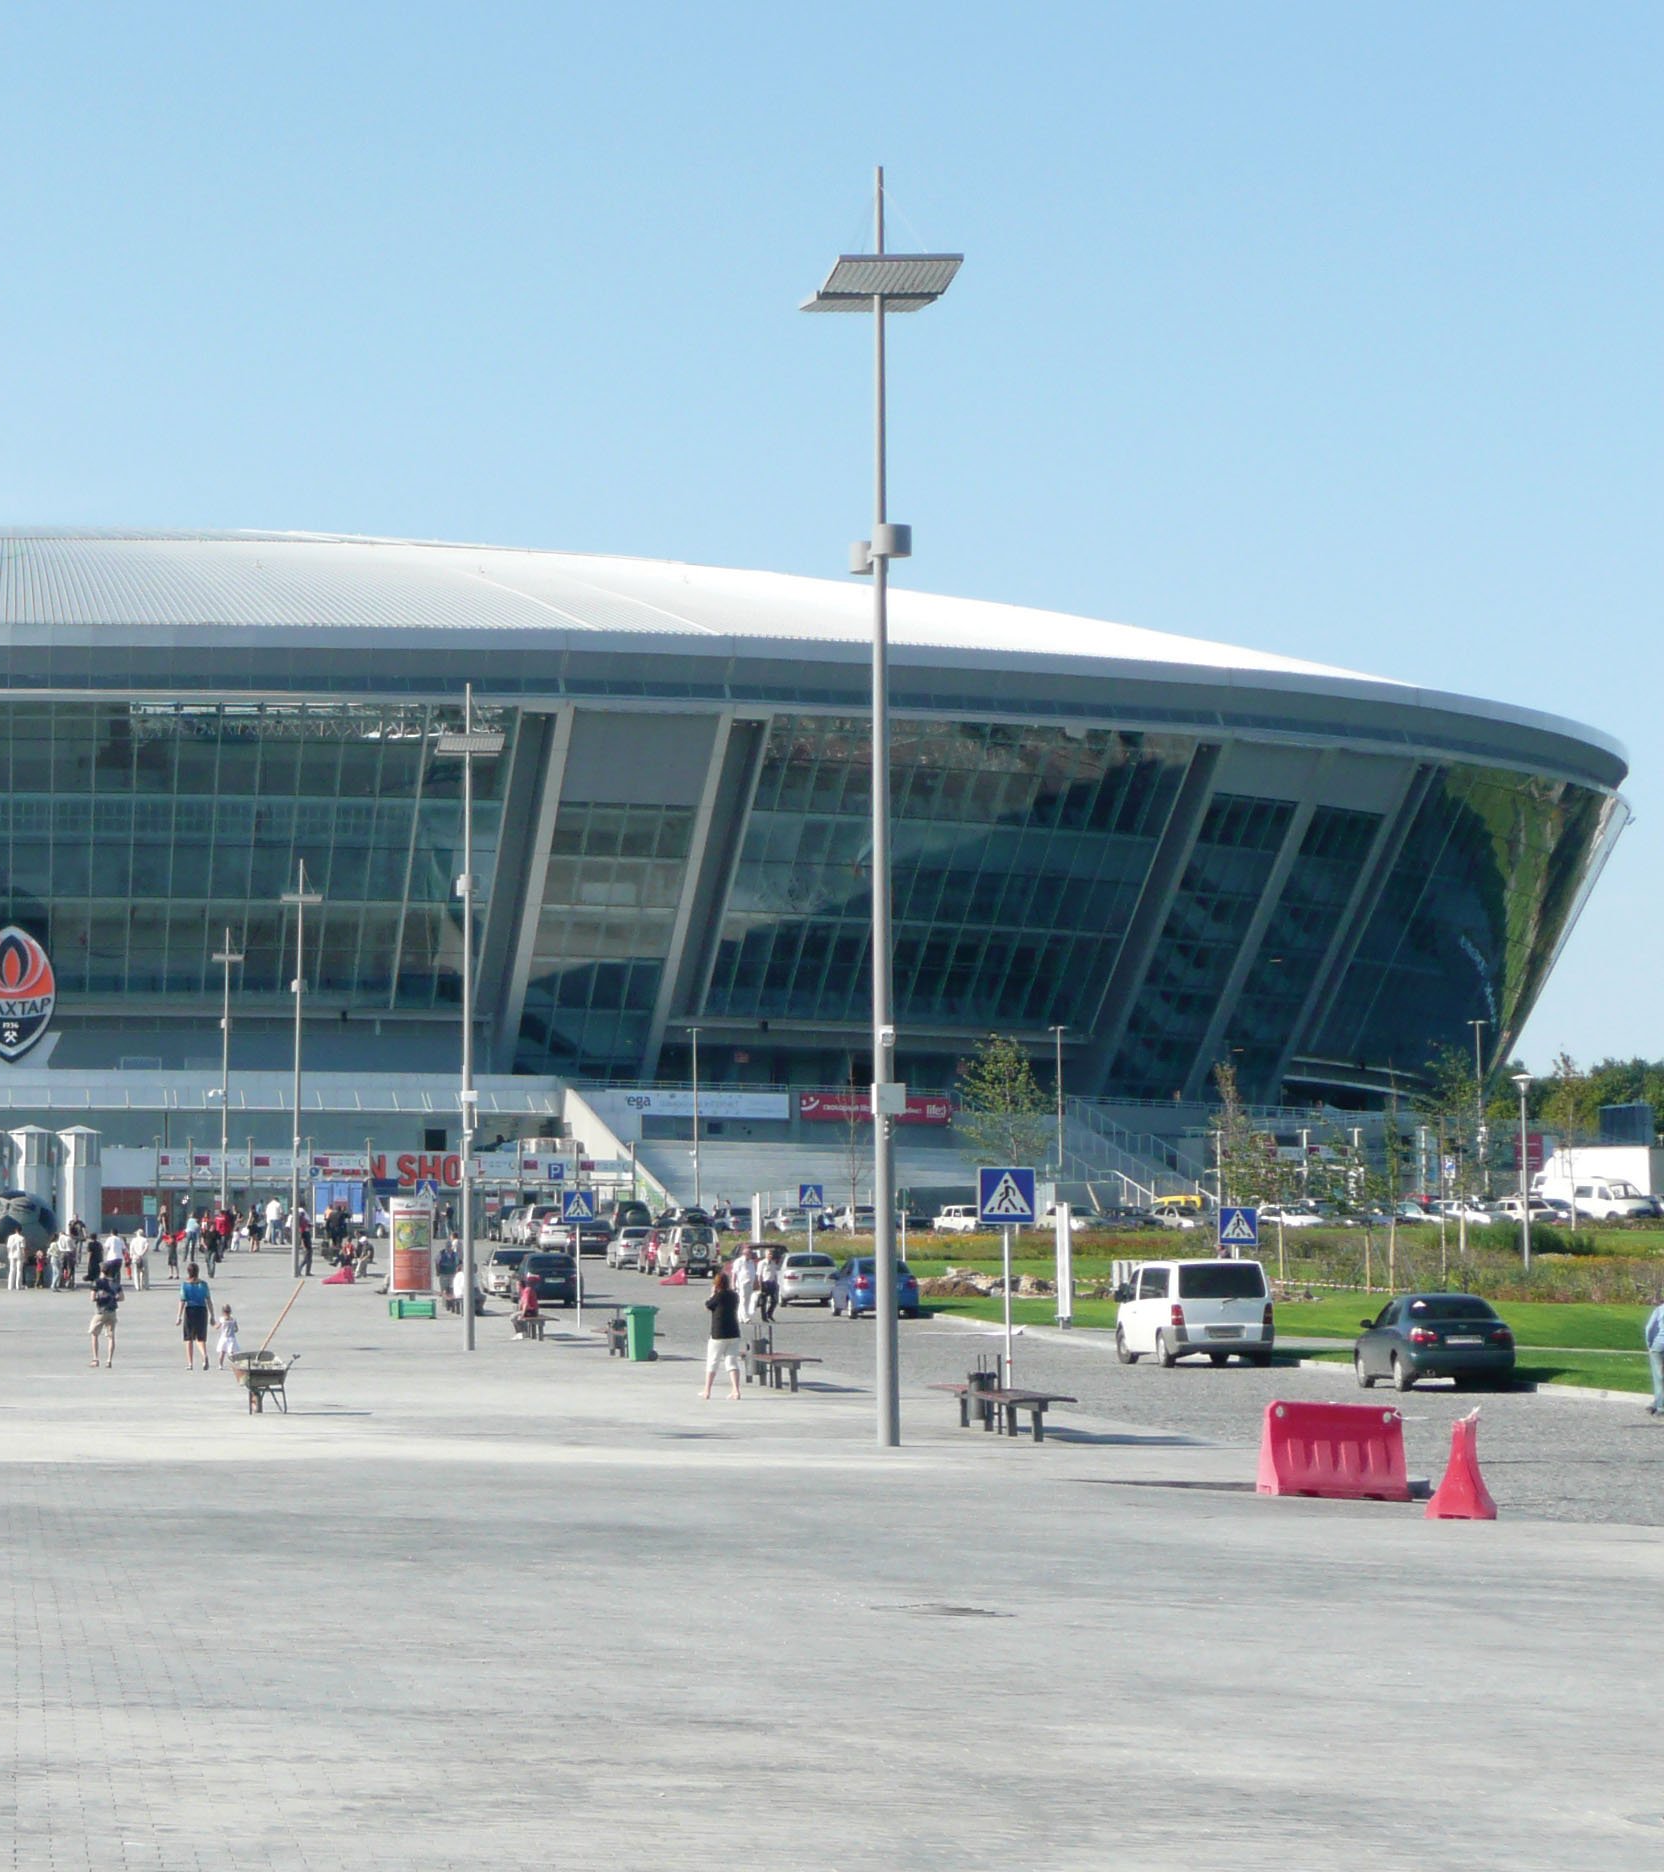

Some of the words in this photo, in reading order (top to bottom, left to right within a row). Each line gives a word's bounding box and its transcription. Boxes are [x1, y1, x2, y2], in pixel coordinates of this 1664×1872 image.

[624, 1095, 652, 1110] ega
[398, 1154, 485, 1188] SHO
[551, 1165, 561, 1178] P
